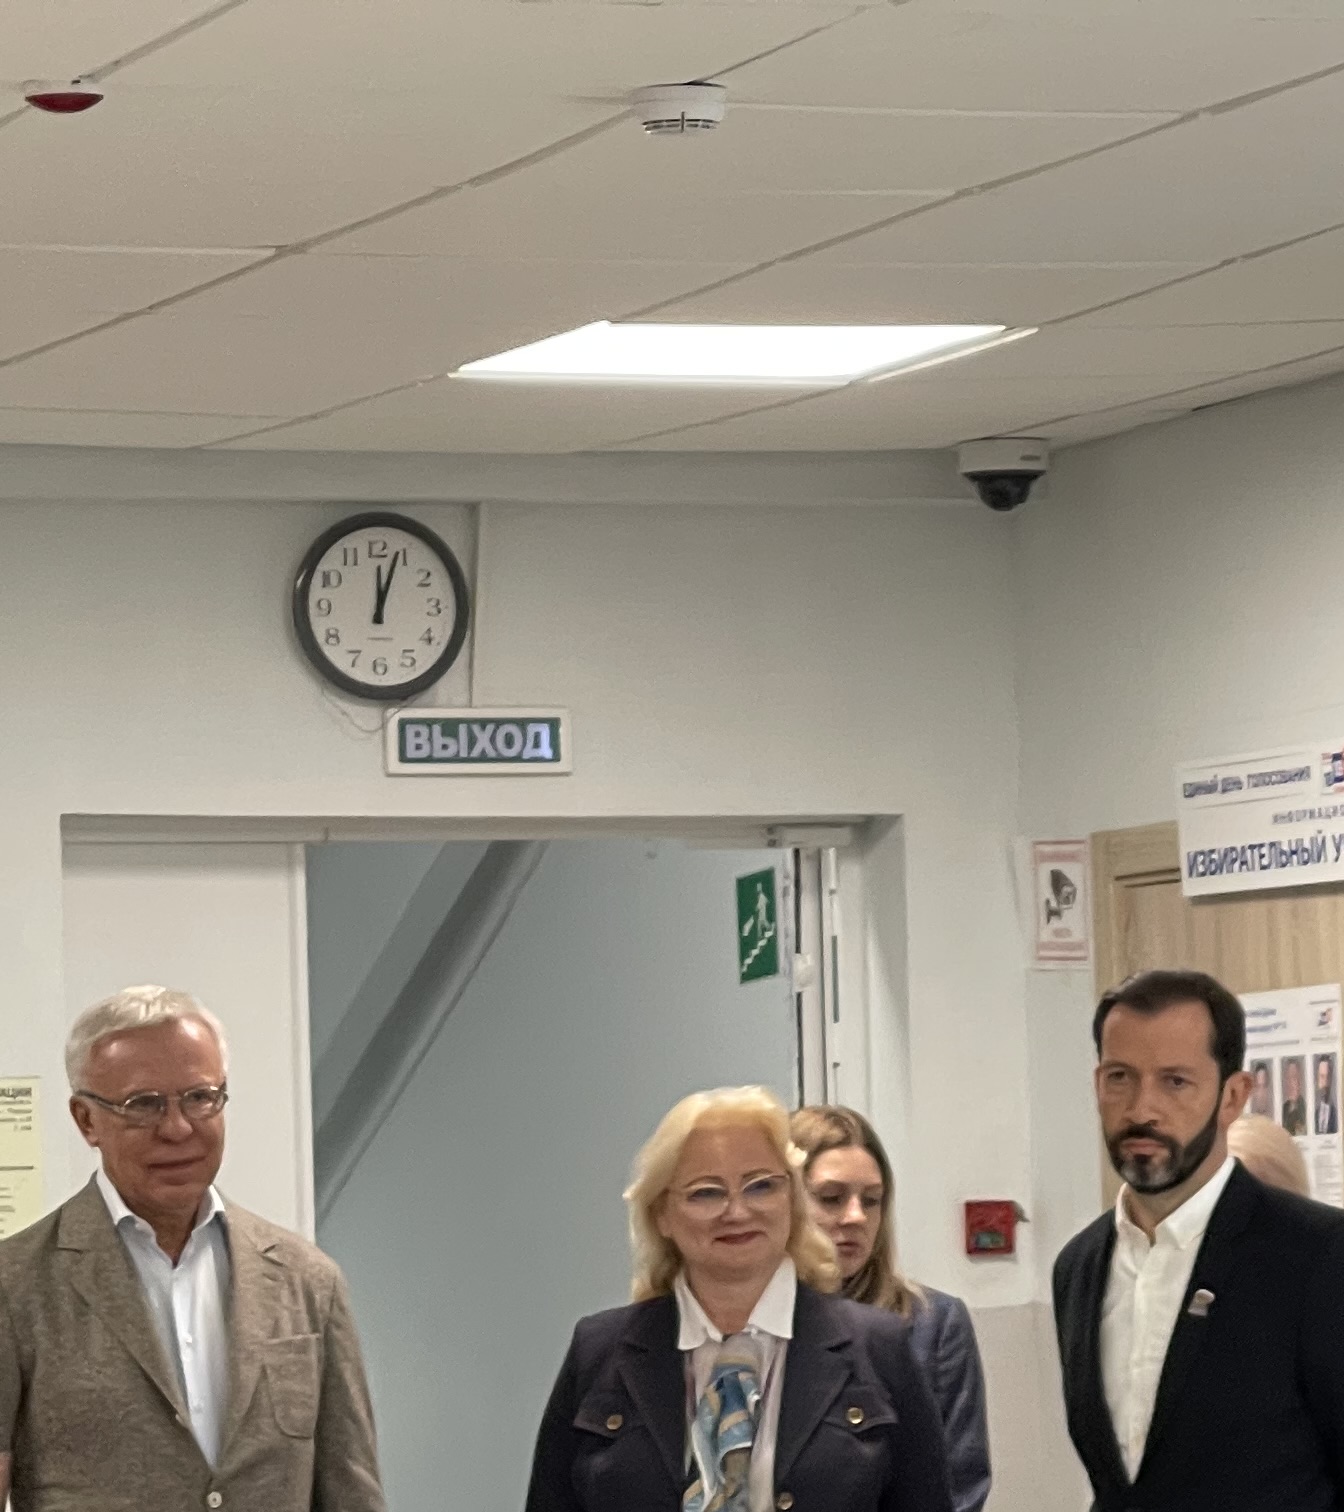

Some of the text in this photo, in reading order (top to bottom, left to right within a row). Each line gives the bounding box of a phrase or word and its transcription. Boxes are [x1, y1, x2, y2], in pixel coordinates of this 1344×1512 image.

[343, 547, 358, 566] 11
[368, 540, 388, 558] 12
[321, 569, 342, 588] 10
[416, 568, 432, 587] 2
[316, 597, 332, 617] 9
[426, 597, 442, 617] 3
[325, 627, 341, 646] 8
[419, 627, 434, 645] 4
[347, 650, 362, 668] 7
[372, 657, 388, 676] 6
[400, 649, 416, 668] 5
[405, 723, 553, 759] ВЫХОД
[1187, 830, 1328, 879] ИЗБИРАТЕЛЬНЫЙ
